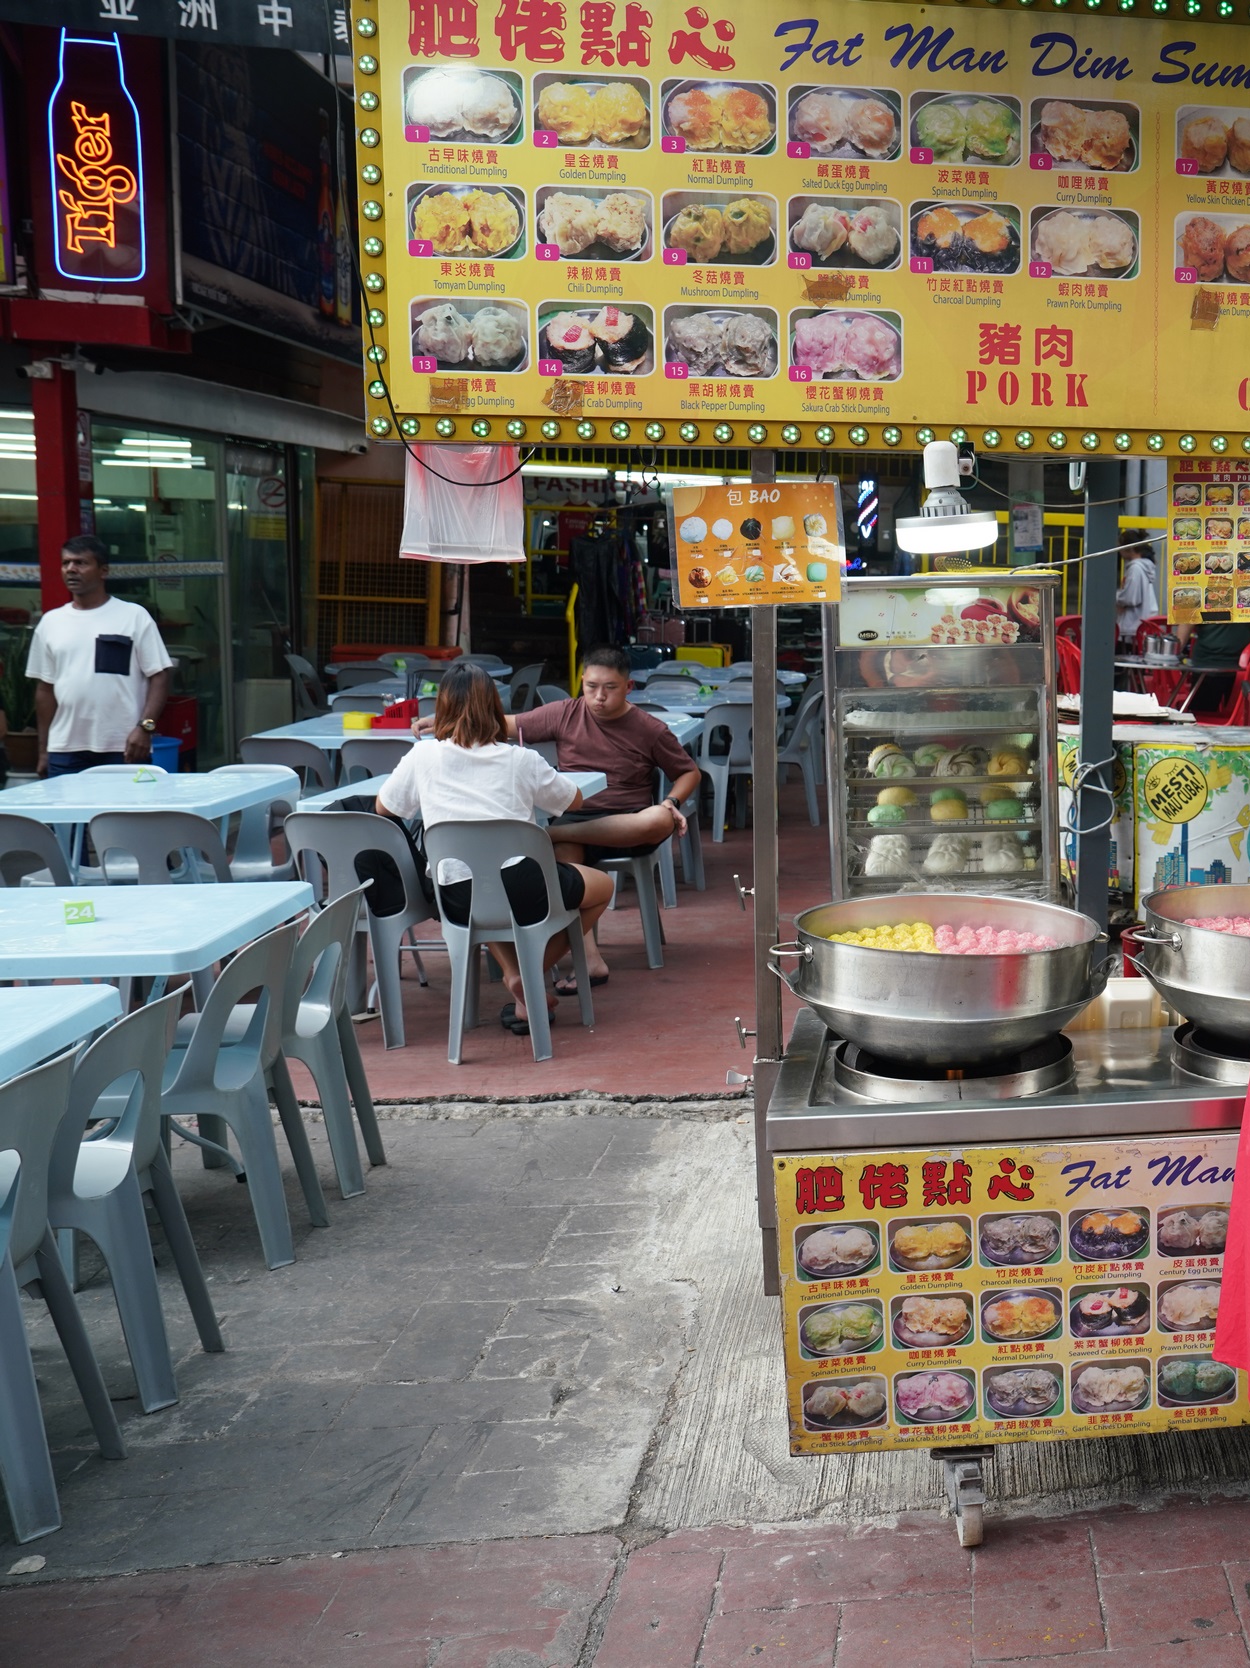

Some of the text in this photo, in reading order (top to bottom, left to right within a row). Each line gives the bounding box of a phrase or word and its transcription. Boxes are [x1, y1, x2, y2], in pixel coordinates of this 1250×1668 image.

[408, 0, 736, 72] 肥佬點心
[774, 18, 866, 72] Fat
[884, 23, 1009, 75] Man
[1030, 32, 1134, 82] Dim
[414, 129, 420, 138] 1
[542, 134, 549, 144] 2
[671, 141, 677, 150] 3
[796, 146, 802, 154] 4
[428, 148, 498, 164] 古早味燒賣
[564, 154, 618, 169] 皇金燒賣
[919, 152, 924, 160] 5
[1038, 158, 1044, 166] 6
[422, 164, 508, 178] Tranditional Dumpling
[692, 158, 746, 174] 紅點燒賣
[1182, 164, 1192, 172] 17
[57, 101, 137, 253] Tiger
[560, 169, 626, 182] Golden Dumpling
[688, 174, 753, 187] Normal Dumpling
[938, 169, 990, 186] 波菜燒賣
[802, 178, 888, 193] Salted Duck Egg Dumpling
[1058, 176, 1109, 191] 咖哩燒賣
[932, 186, 998, 200] Spinach Dumpling
[1056, 192, 1112, 205] Curry Dumpling
[1186, 194, 1206, 204] Yellow
[1208, 196, 1220, 204] Skin
[1221, 196, 1245, 206] Chicken
[419, 244, 424, 253] 7
[544, 248, 551, 258] 8
[441, 262, 496, 278] 東炎燒賣
[567, 266, 621, 282] 辣椒燒賣
[434, 279, 506, 294] Tomyam Dumpling
[568, 282, 623, 296] Chili Dumpling
[979, 323, 1074, 367] 豬肉
[966, 370, 1090, 408] PORK
[726, 489, 780, 506] 包 BAO
[1151, 764, 1195, 810] MESTI
[1162, 776, 1204, 820] MAU CUBA!
[66, 905, 93, 920] 24
[1061, 1160, 1132, 1197] Fat
[795, 1158, 1034, 1215] 肥佬點心
[906, 1272, 955, 1284] 皇金燒賣
[1106, 1271, 1142, 1280] Dumpling
[928, 1280, 963, 1290] Dumpling
[1068, 1346, 1152, 1357] Seaweed Crab Dumpling
